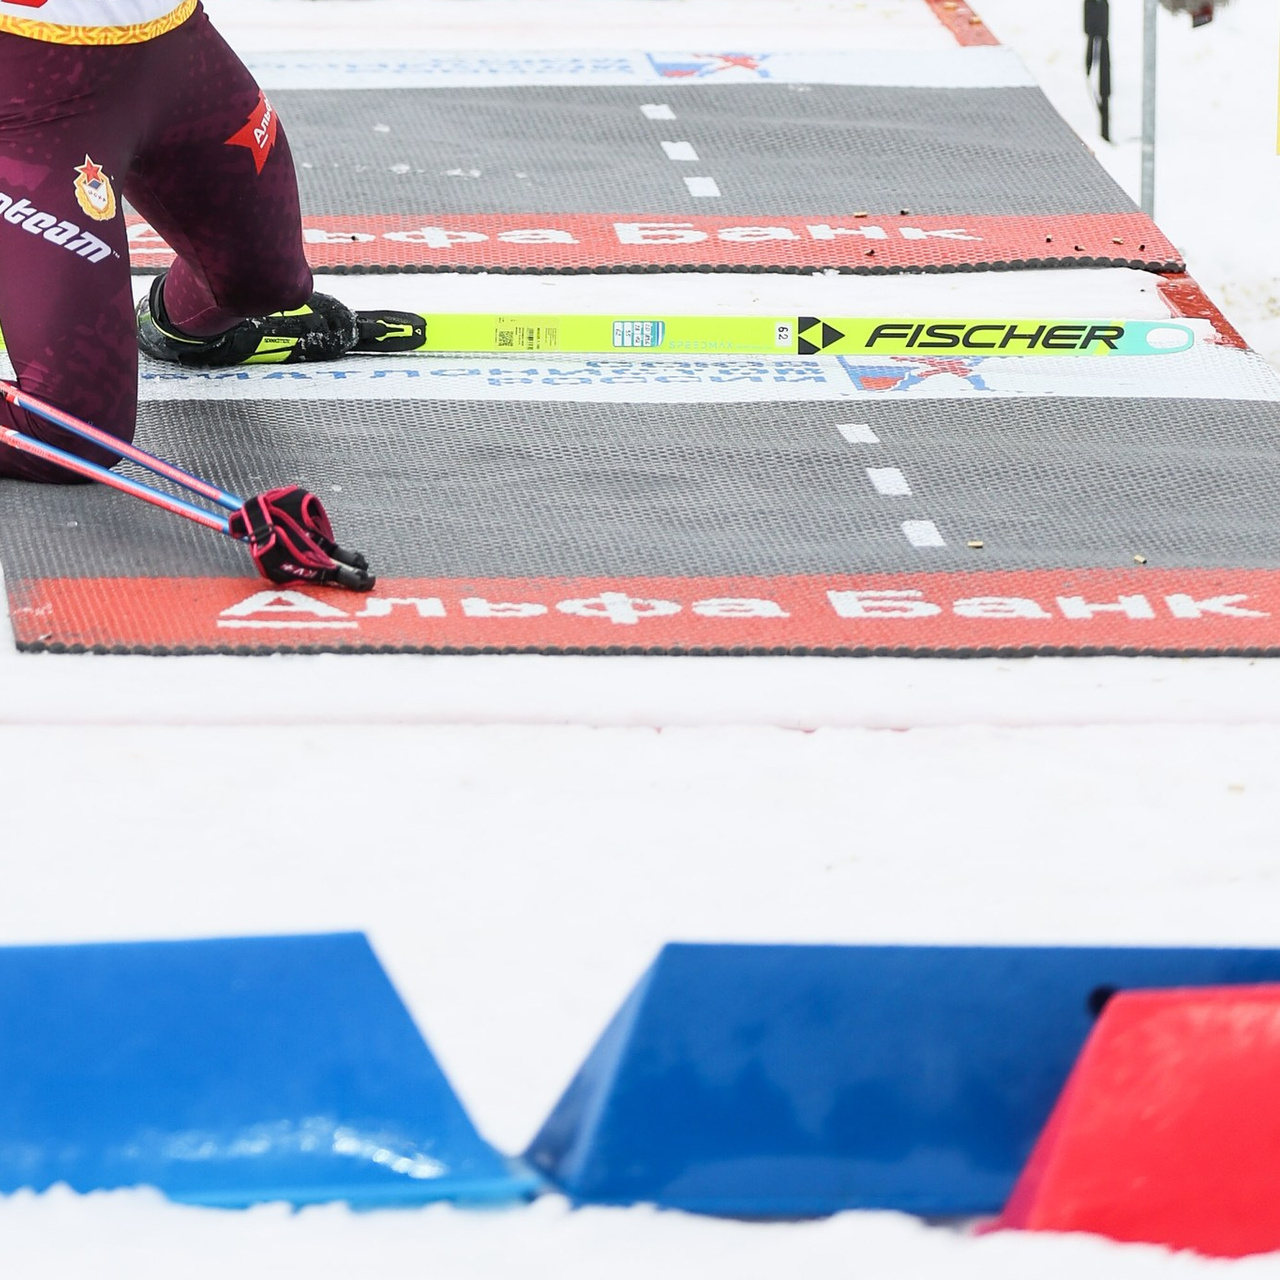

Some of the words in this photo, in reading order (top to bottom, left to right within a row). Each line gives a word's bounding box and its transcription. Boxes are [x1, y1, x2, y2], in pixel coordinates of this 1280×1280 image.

[611, 221, 986, 245] Банк
[777, 326, 789, 341] 62
[864, 323, 1126, 350] FISCHER
[215, 588, 791, 630] Альфа
[823, 588, 1271, 622] Банк
